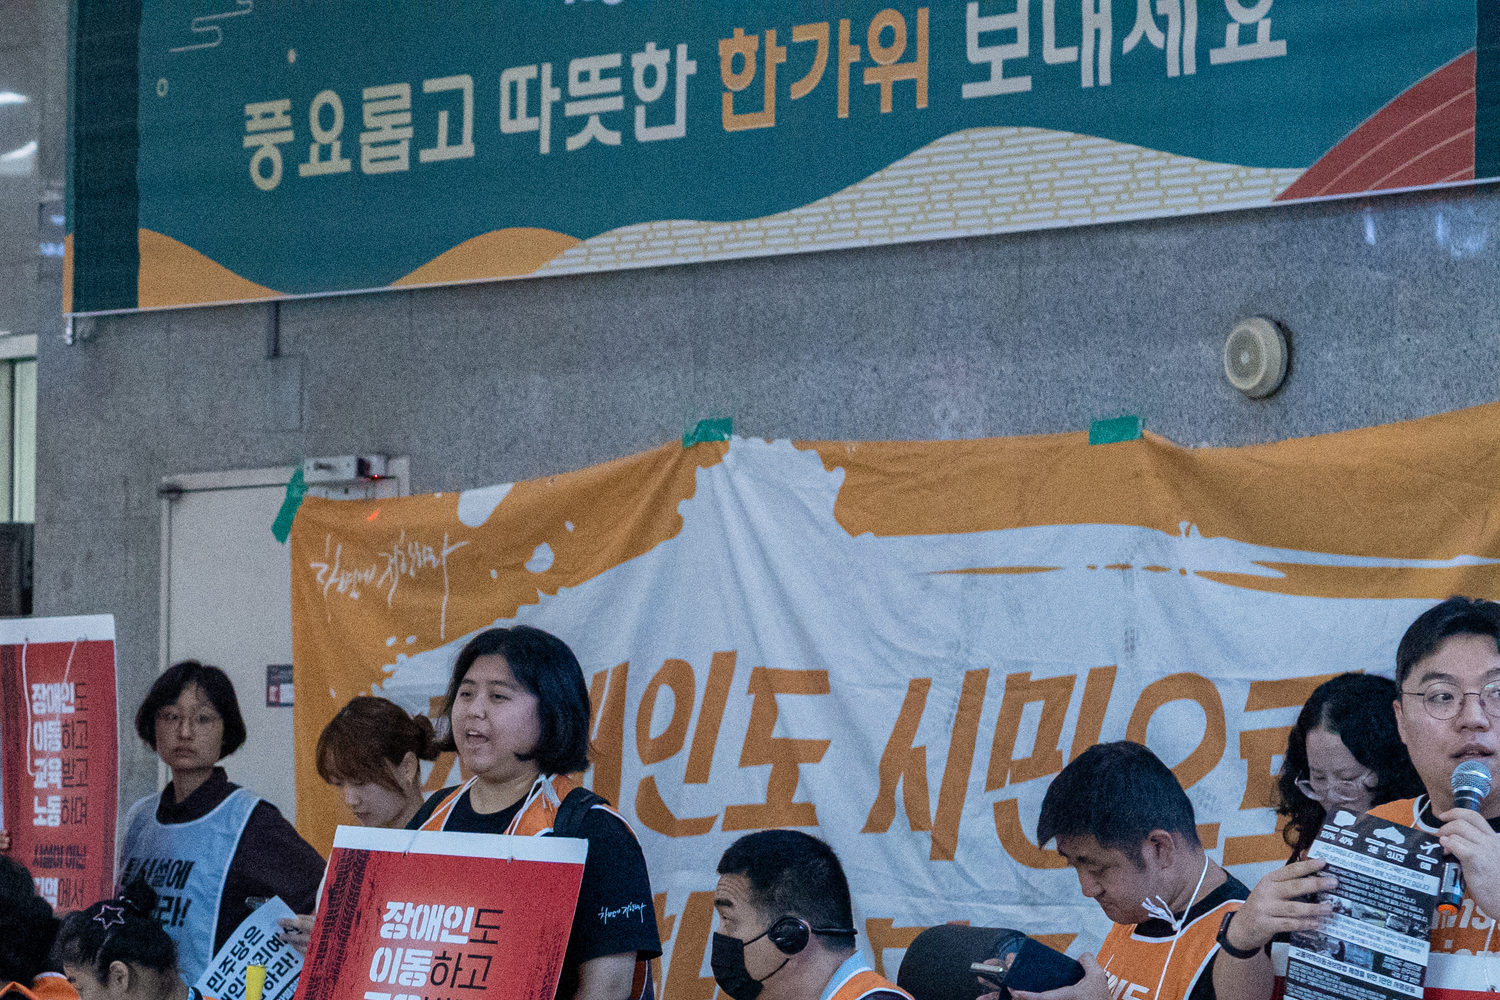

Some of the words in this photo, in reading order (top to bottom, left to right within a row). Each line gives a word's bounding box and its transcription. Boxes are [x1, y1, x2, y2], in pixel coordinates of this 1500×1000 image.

[243, 73, 475, 191] 풍요롭고
[499, 42, 697, 154] 따뜻한
[719, 7, 929, 132] 한가위
[961, 0, 1288, 99] 보내세요
[32, 682, 88, 715] 장애인도
[33, 719, 88, 752] 이동하고
[33, 757, 88, 789] 교육받고
[33, 796, 88, 827] 노동하며
[380, 901, 504, 946] 장애인도
[206, 926, 265, 993] 민주당은
[369, 947, 493, 990] 이동하고
